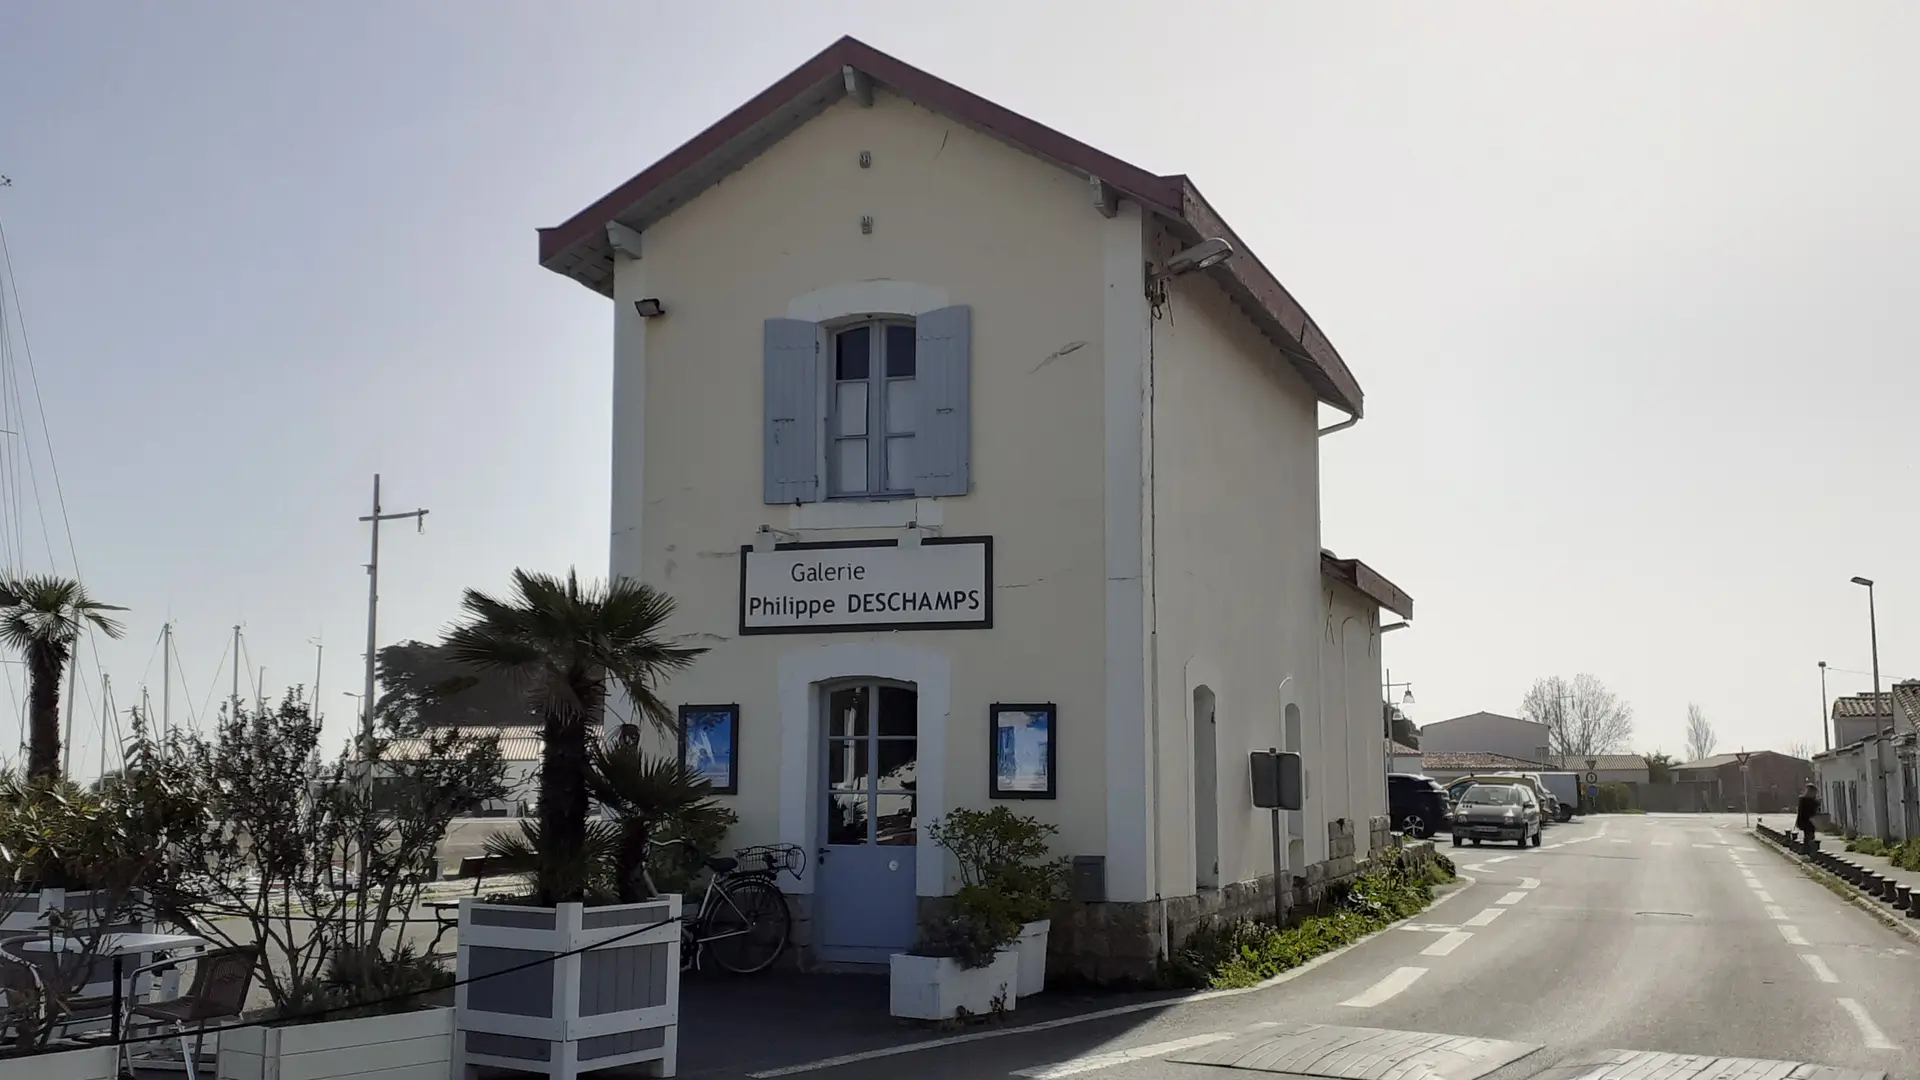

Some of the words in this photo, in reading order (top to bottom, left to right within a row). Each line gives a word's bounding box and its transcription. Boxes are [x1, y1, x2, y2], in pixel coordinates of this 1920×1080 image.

[791, 562, 865, 582] Galerie
[750, 596, 835, 619] Philippe
[848, 590, 979, 613] DESCHAMPS
